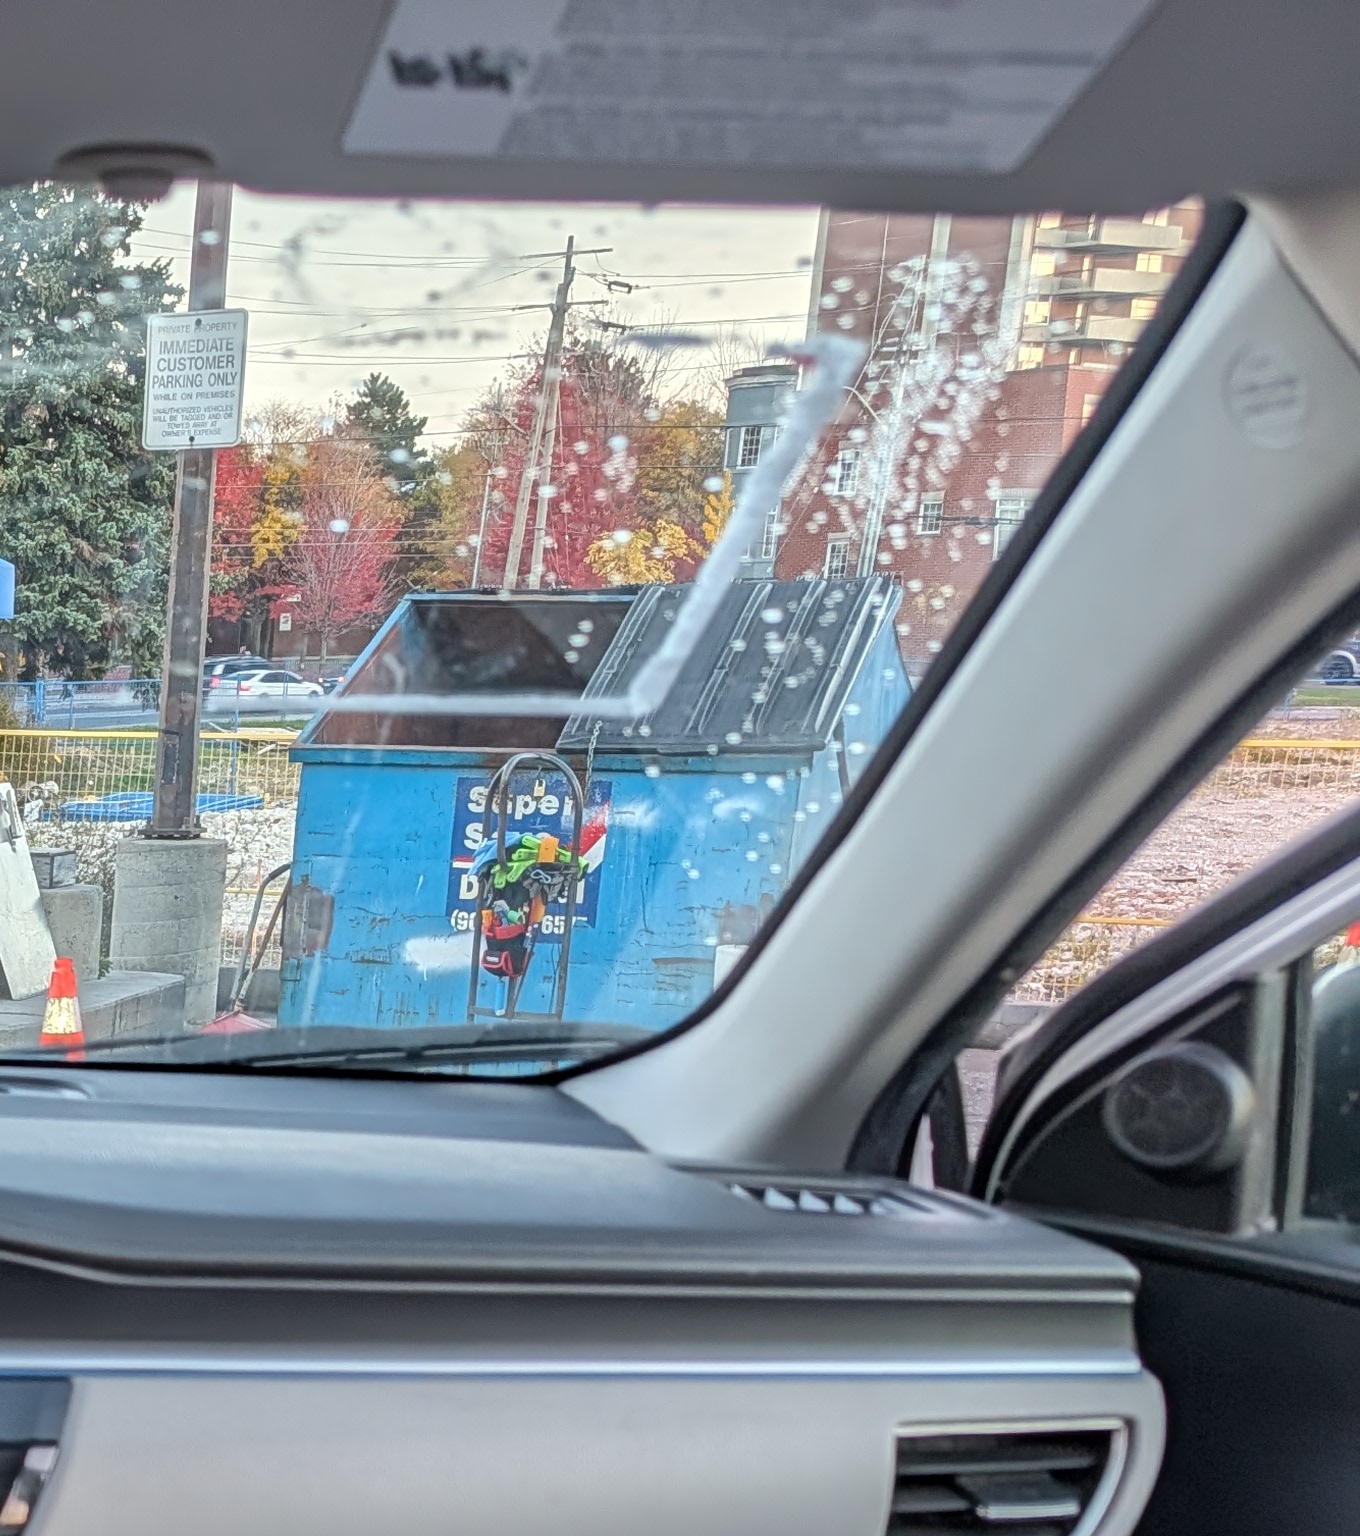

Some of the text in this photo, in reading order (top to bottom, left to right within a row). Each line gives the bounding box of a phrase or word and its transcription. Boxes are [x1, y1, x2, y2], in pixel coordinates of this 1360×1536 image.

[158, 322, 238, 334] PRIVATE PROPERTY
[159, 337, 234, 355] IMMEDIATE
[157, 355, 235, 372] CUSTOMER
[152, 371, 238, 389] PARKING ONLY
[153, 390, 235, 401] WHILE ON PREMISES
[153, 404, 234, 415] UNAUTHORIZED VEHICLES
